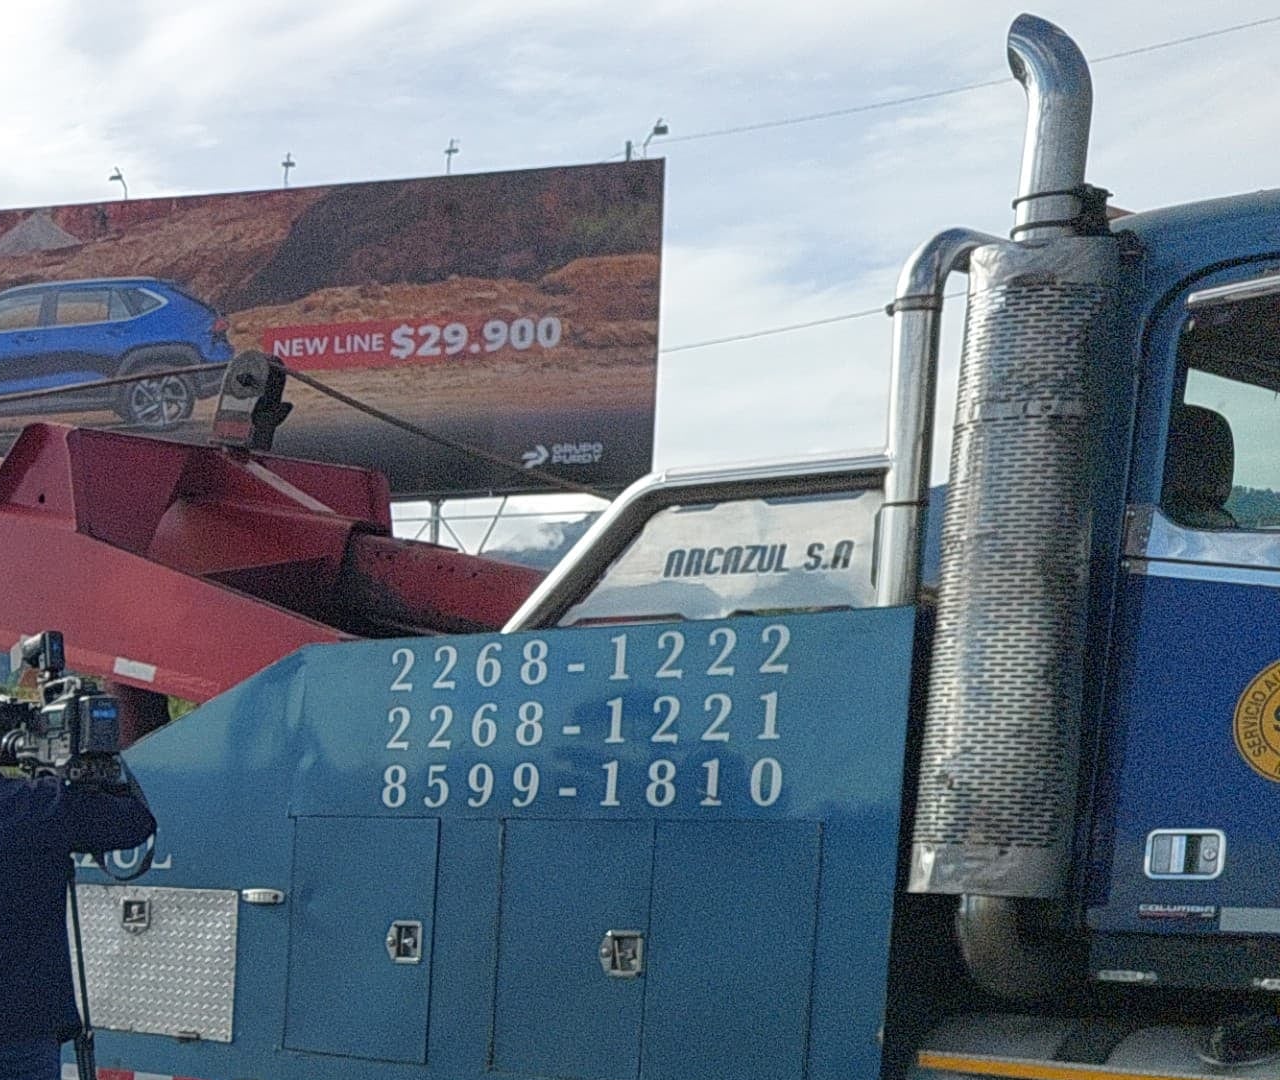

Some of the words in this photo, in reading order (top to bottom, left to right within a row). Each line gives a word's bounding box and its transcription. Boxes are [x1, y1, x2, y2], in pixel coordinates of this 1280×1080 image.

[273, 337, 328, 357] NEW
[333, 333, 385, 353] LINE
[390, 317, 562, 359] $29.900
[663, 543, 790, 578] ARCAZUL
[804, 540, 855, 571] S.A
[390, 624, 791, 693] 2268-1222
[385, 691, 781, 751] 2268-1221
[1241, 690, 1268, 757] SERVICIO
[381, 757, 783, 809] 8599-1810
